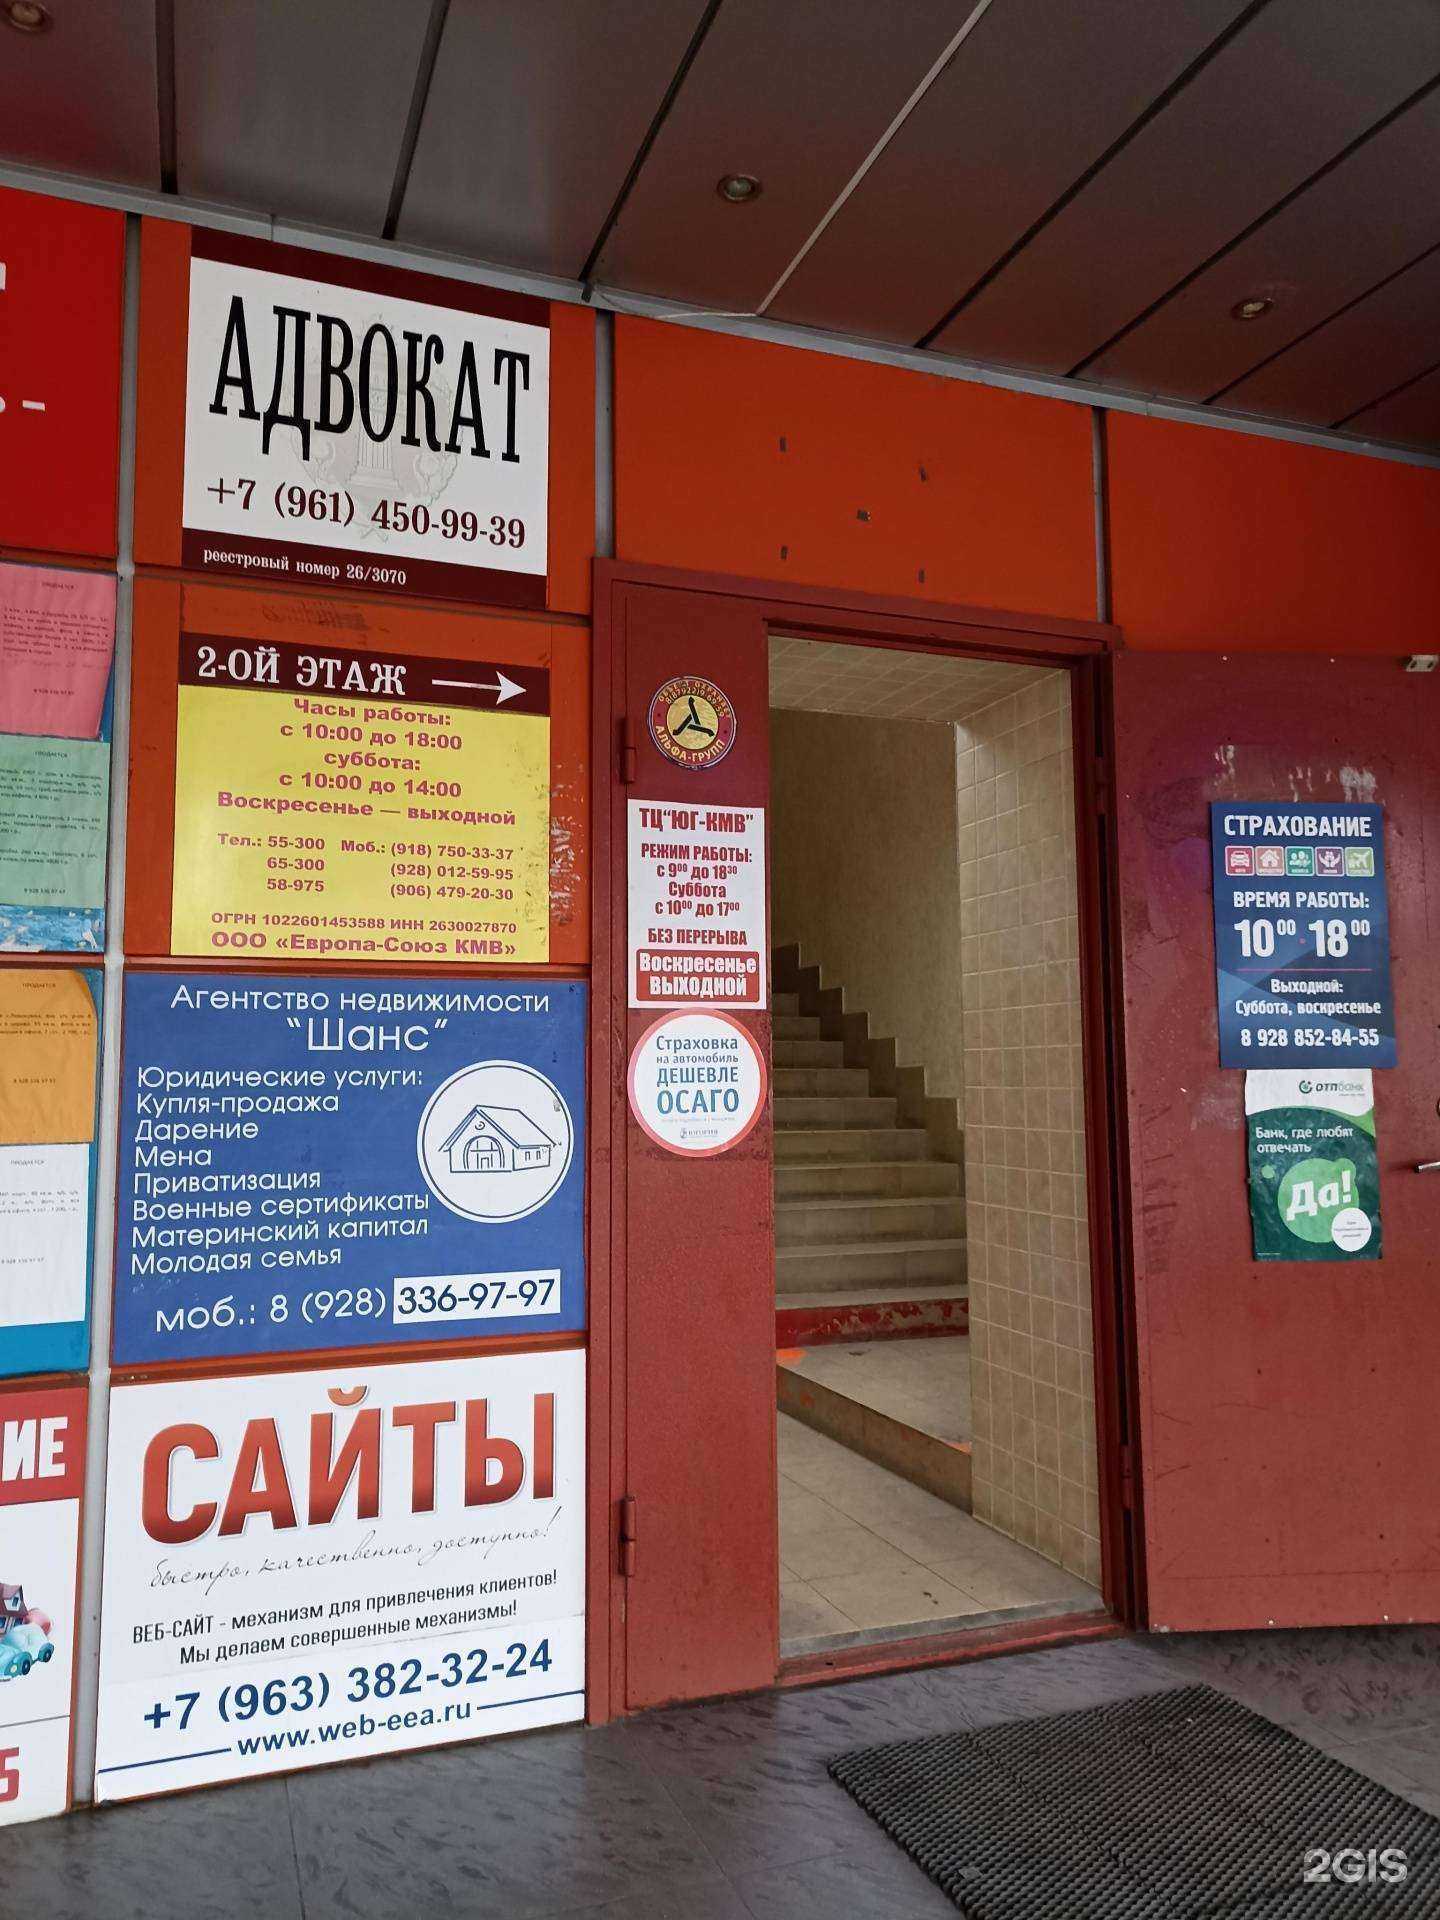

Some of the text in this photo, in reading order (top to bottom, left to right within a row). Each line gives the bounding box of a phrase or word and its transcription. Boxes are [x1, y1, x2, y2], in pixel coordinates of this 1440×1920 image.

[209, 295, 530, 464] АДВОКАТ
[207, 477, 526, 549] +7 (961) 450-99-39
[203, 547, 407, 586] реестровый номер 26/3070
[197, 645, 407, 696] 2-ОЙ ЭТАЖ
[294, 698, 452, 726] Часы работы:
[280, 723, 462, 750] с 10:00 до 18:00
[656, 725, 725, 762] АЛЬФА-ГРУПП
[324, 750, 421, 772] суббота:
[279, 772, 462, 799] с 10:00 до 14:00
[218, 791, 374, 817] Воскресенье
[407, 806, 517, 826] выходной
[1224, 815, 1372, 837] СТРАХОВАНИЕ
[218, 833, 325, 851] Тел.: 55-300
[341, 839, 514, 861] Моб.: (918) 750-33-37
[641, 843, 752, 863] РЕЖИМ РАБОТЫ:
[267, 856, 325, 872] 65-300
[390, 862, 514, 881] (928) 012-59-95
[691, 866, 709, 880] до
[267, 878, 324, 893] 58-975
[390, 883, 514, 901] (906) 479-20-30
[668, 881, 726, 898] Суббота
[695, 903, 714, 917] до
[1233, 891, 1369, 908] ВРЕМЯ РАБОТЫ:
[211, 911, 517, 934] ОГРН 1022601453588 ИНН 2630027870
[211, 931, 516, 956] ООО «Европа-Союз КМВ»
[648, 928, 747, 945] БЕЗ ПЕРЕРЫВА
[639, 952, 756, 974] Воскресенье
[1270, 978, 1343, 994] Выходной:
[170, 984, 549, 1014] Агентство недвижимости
[1236, 1000, 1381, 1016] Суббота, воскресенье
[656, 1035, 738, 1053] Страховка
[1241, 1028, 1379, 1047] 8 928 852-84-55
[673, 1052, 739, 1063] автомобиль
[137, 1066, 423, 1091] Юридические услуги:
[656, 1066, 739, 1087] ДЕШЕВЛЕ
[136, 1092, 339, 1117] Купля-продажа
[657, 1088, 739, 1114] ОСАГО
[134, 1118, 259, 1144] Дарение
[1256, 1126, 1353, 1141] Банк, где любят
[134, 1145, 213, 1168] Мена
[1256, 1143, 1312, 1153] отвечать
[133, 1169, 321, 1198] Приватизация
[1286, 1169, 1352, 1221] Да!
[133, 1191, 429, 1222] Военные сертификаты
[131, 1217, 429, 1248] Материнский капитал
[131, 1248, 342, 1276] Молодая семья
[155, 1278, 556, 1333] моб.: 8 (928) 336-97-97
[141, 1385, 555, 1545] САЙТЫ
[149, 1505, 562, 1597] быстро, качественно, доступно!
[132, 1611, 214, 1645] ВЕБ-САЙТ
[231, 1604, 323, 1631] механизм
[328, 1598, 362, 1619] для
[366, 1585, 474, 1614] привлечения
[479, 1569, 558, 1595] клиентов!
[180, 1600, 518, 1666] Мы делаем совершенные механизмы!
[144, 1638, 553, 1731] +7 (963) 382-32-24
[237, 1702, 473, 1757] www.web-eea.ru
